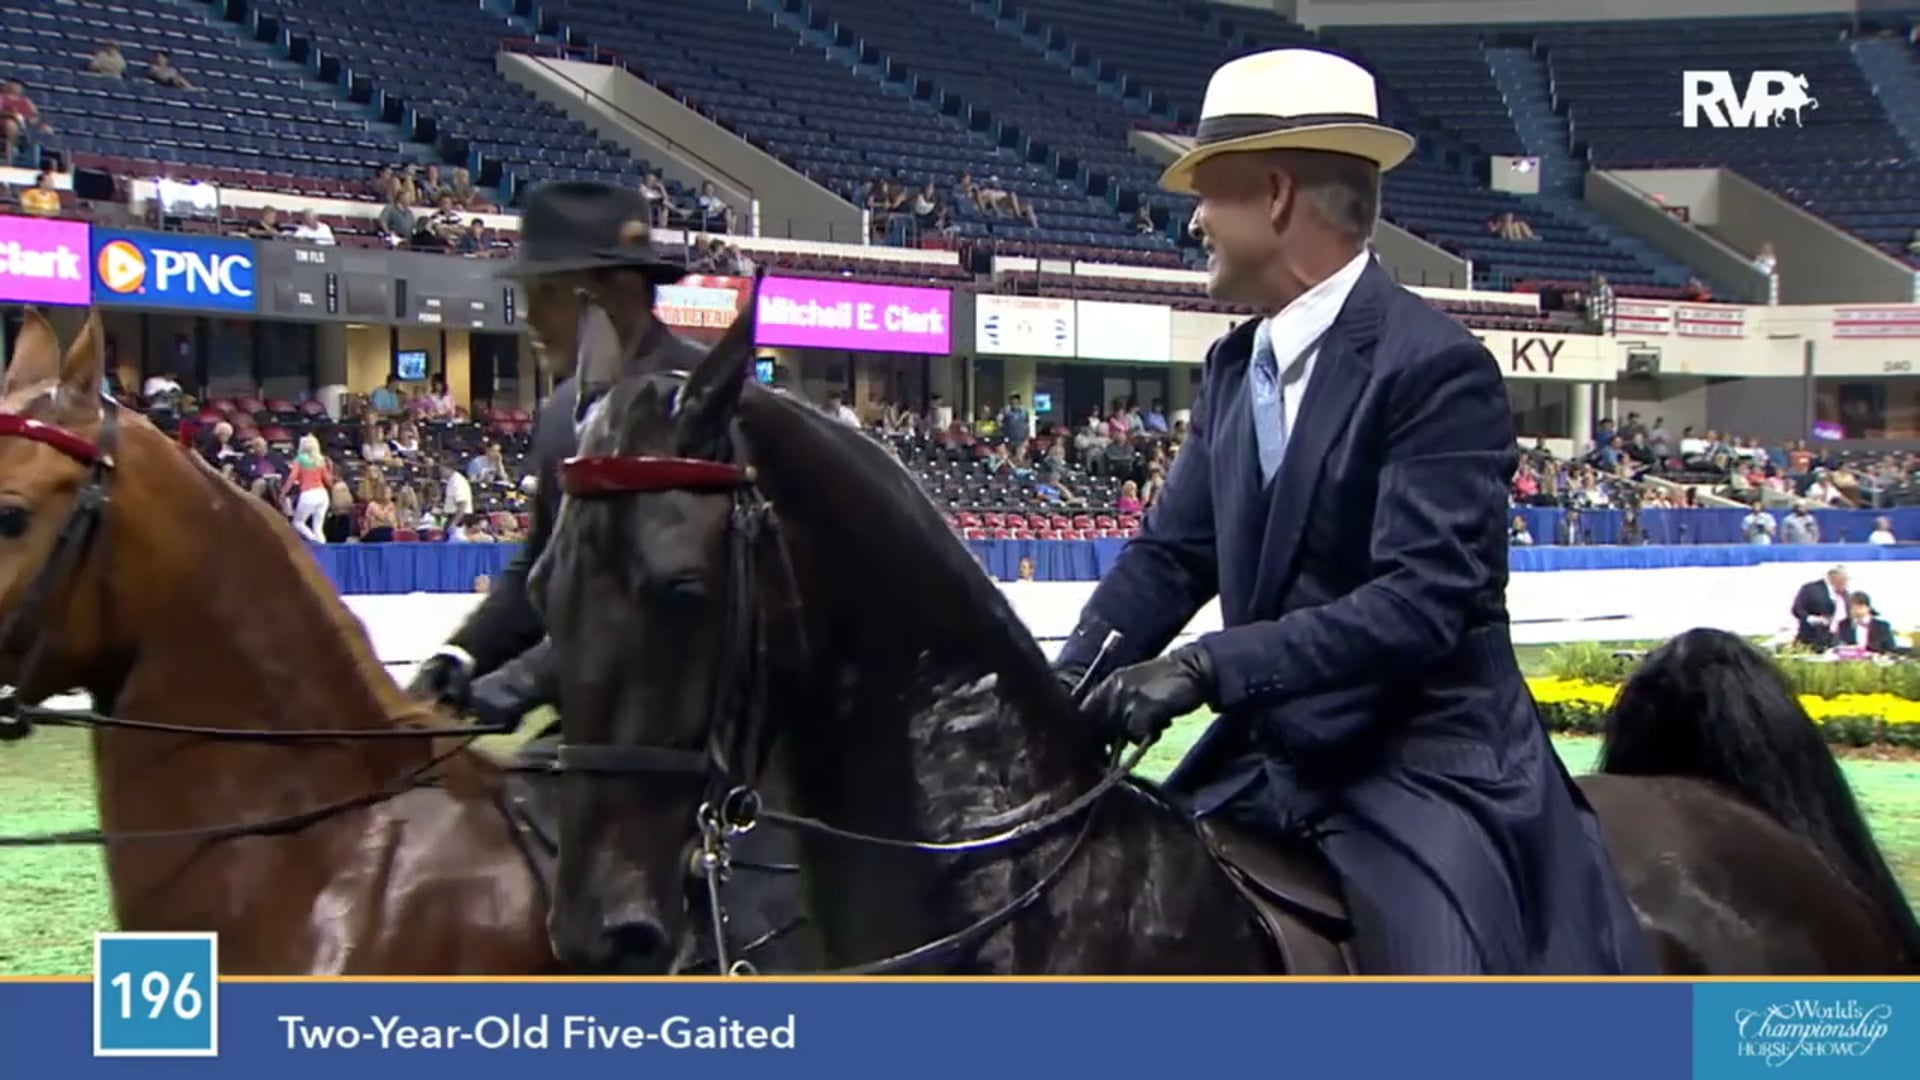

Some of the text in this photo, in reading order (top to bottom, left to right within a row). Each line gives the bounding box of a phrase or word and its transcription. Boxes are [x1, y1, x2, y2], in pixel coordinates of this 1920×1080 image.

[151, 248, 252, 297] PNC
[758, 294, 853, 330] Mitchell
[884, 303, 944, 335] Clark
[1511, 337, 1565, 373] KY
